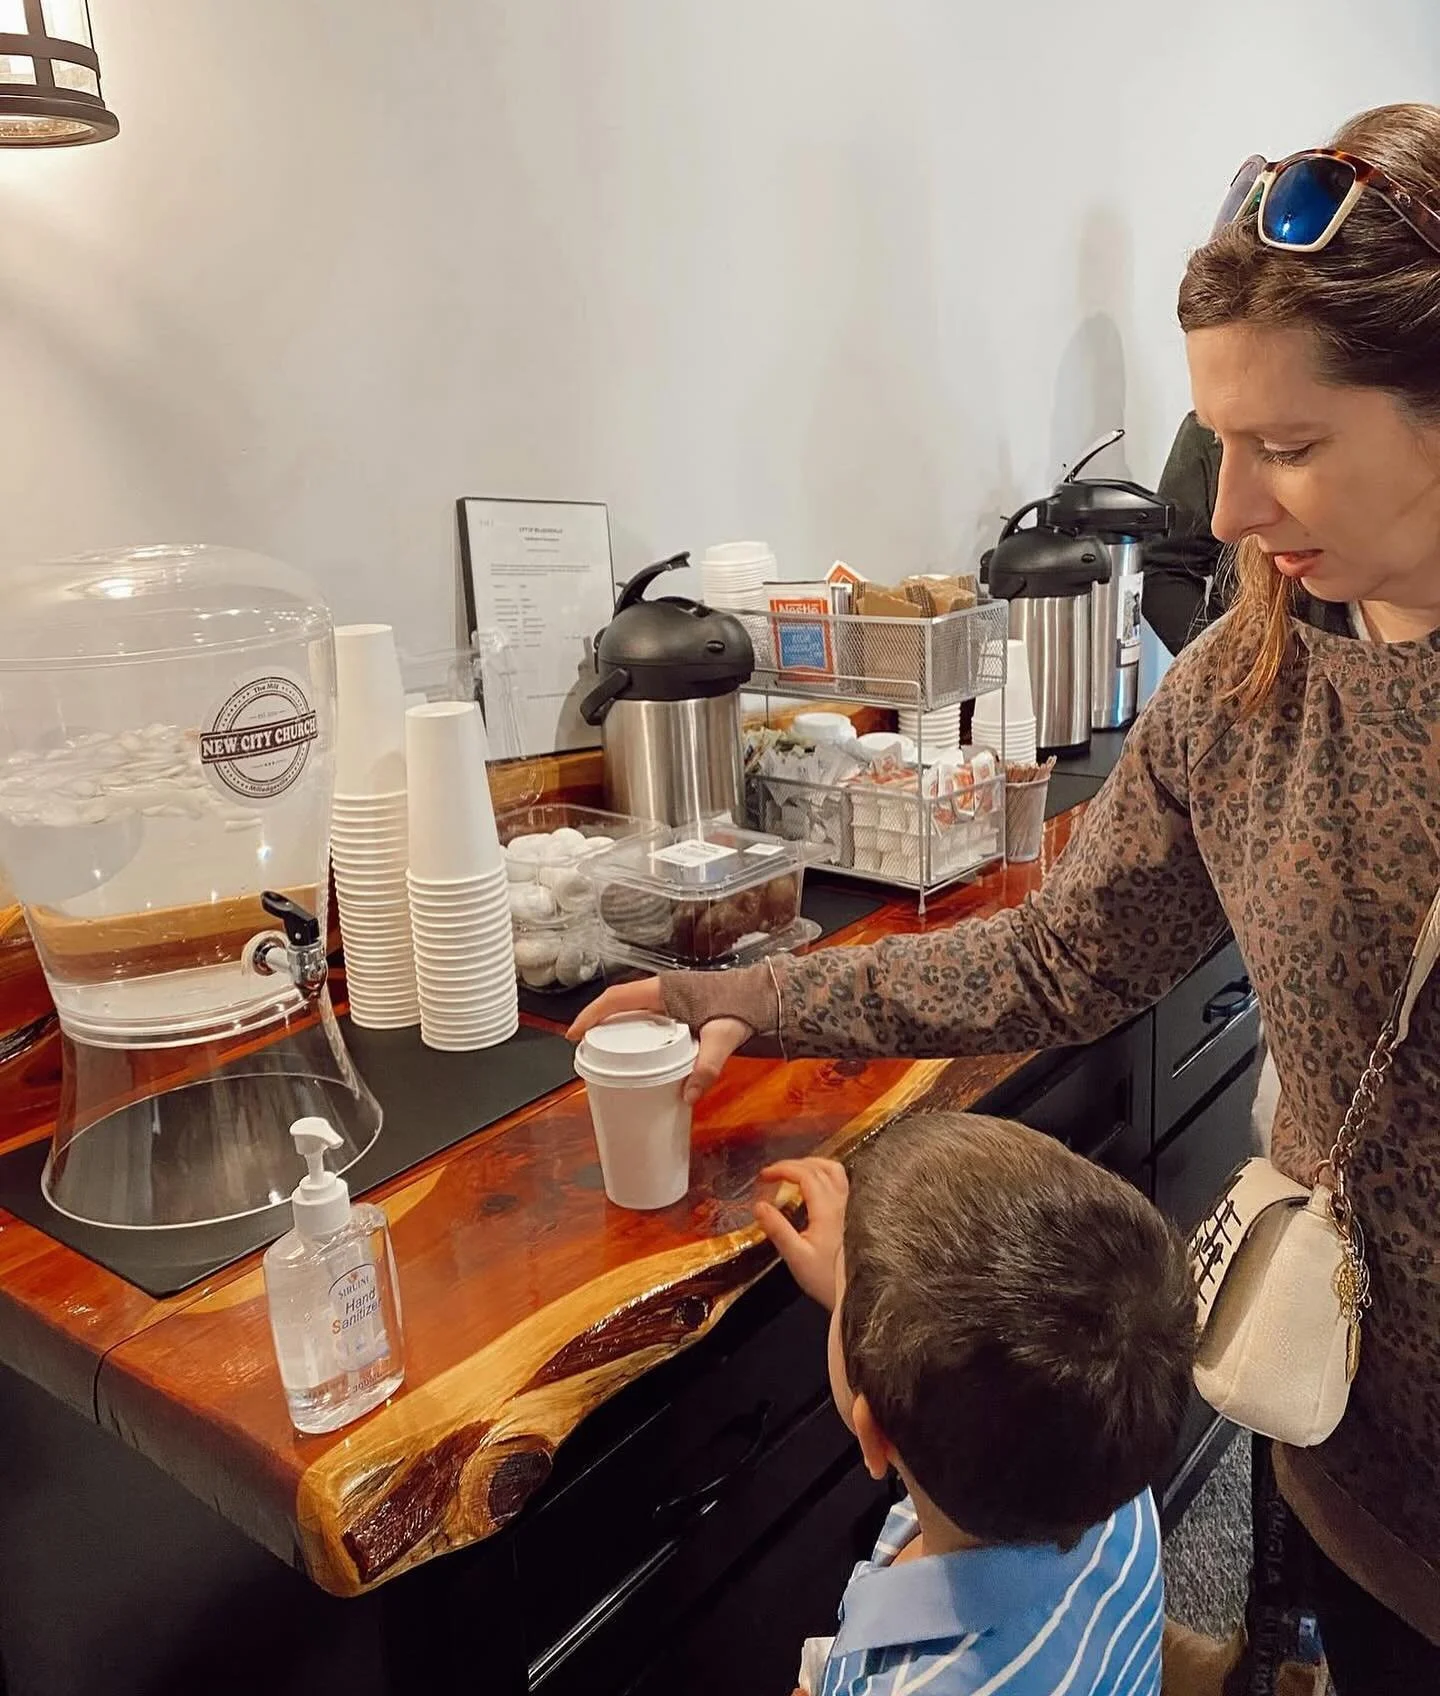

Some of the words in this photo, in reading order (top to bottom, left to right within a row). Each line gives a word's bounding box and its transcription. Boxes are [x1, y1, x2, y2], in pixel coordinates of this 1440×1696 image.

[202, 736, 238, 757] NEW
[240, 730, 272, 751] CITY
[274, 718, 316, 745] CHURCH
[332, 1297, 382, 1335] Sanitizer
[345, 1286, 376, 1315] Hand
